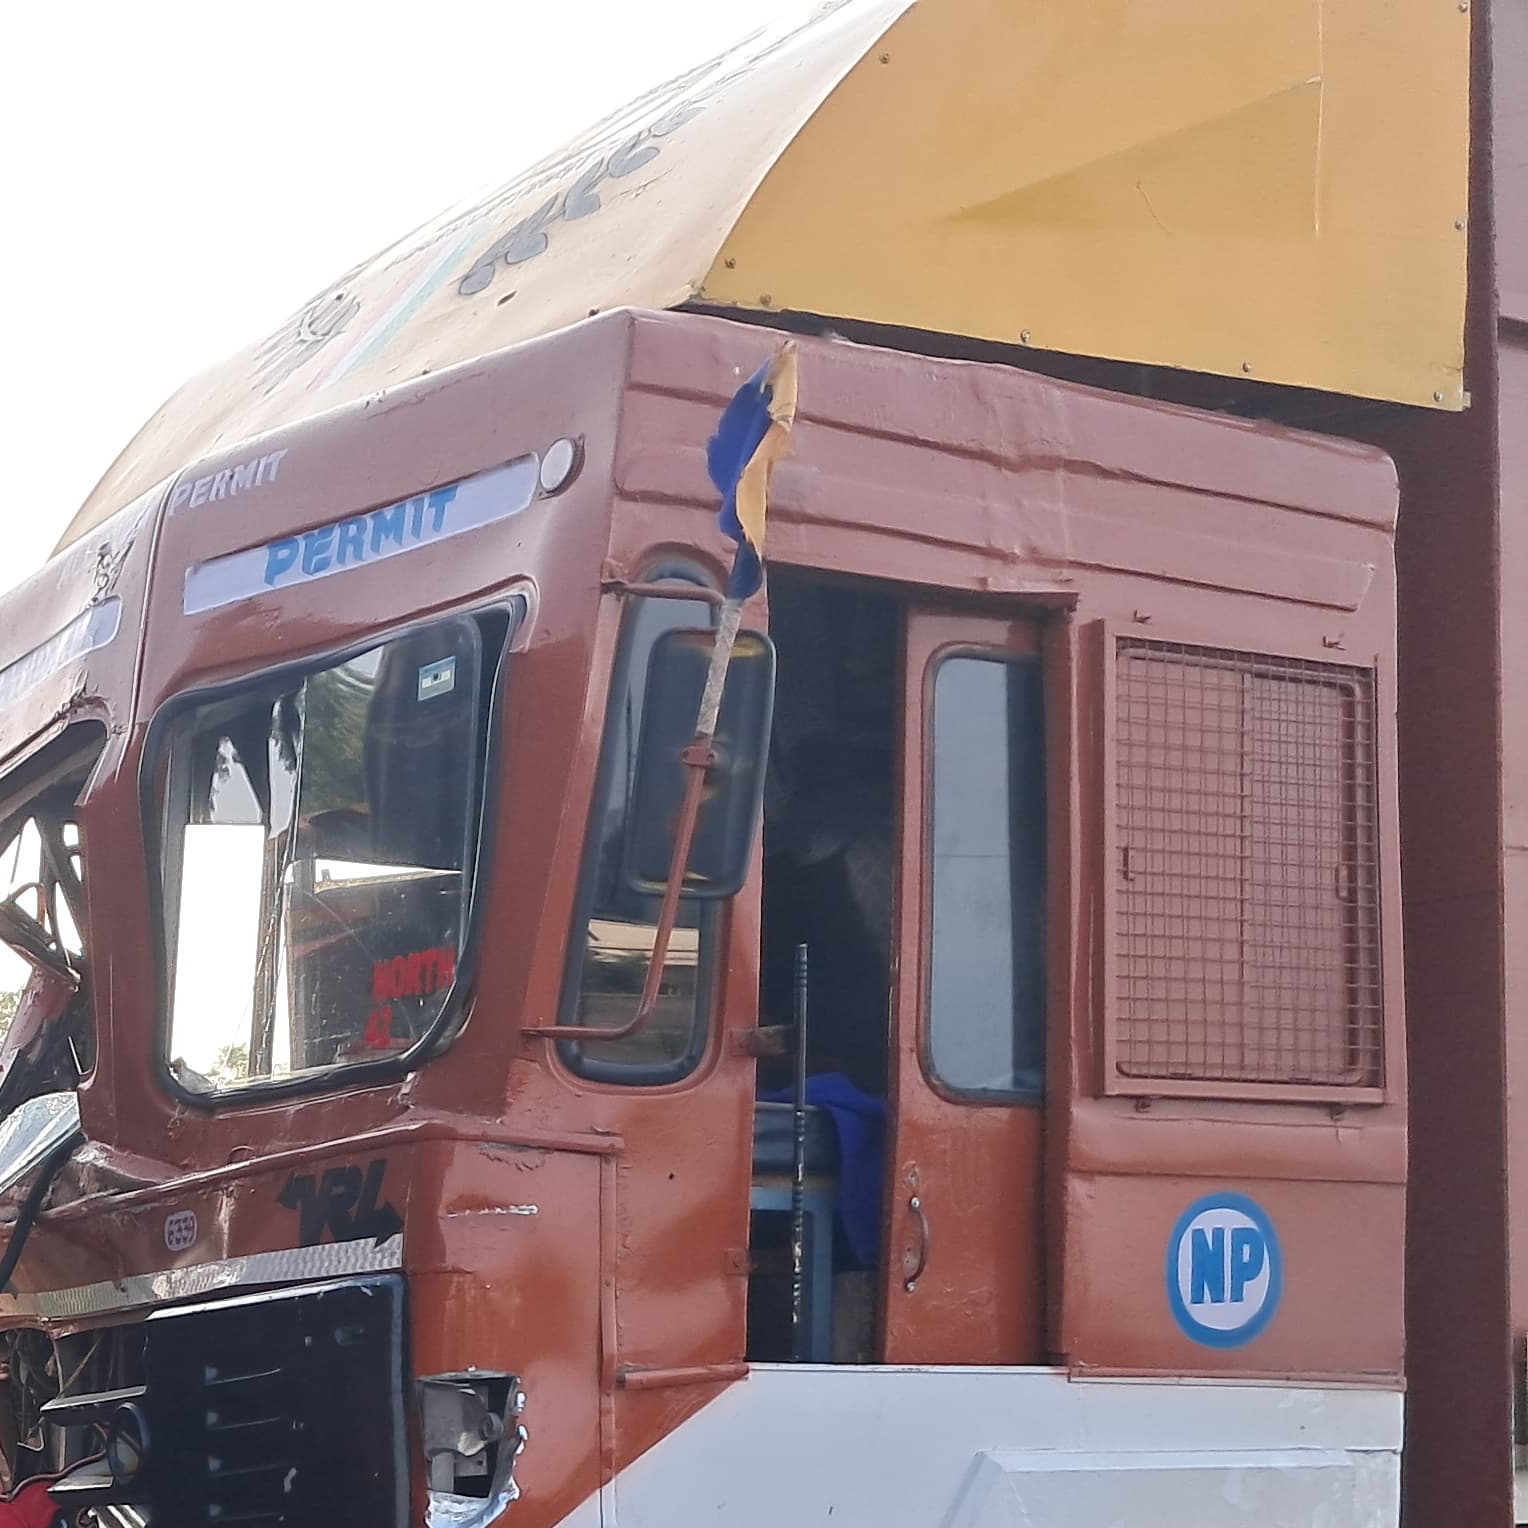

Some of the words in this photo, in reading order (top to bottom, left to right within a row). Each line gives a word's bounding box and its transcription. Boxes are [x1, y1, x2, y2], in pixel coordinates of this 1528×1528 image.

[168, 448, 289, 517] PERMIT
[263, 484, 459, 588] PERMIT
[1190, 1226, 1266, 1305] NP
